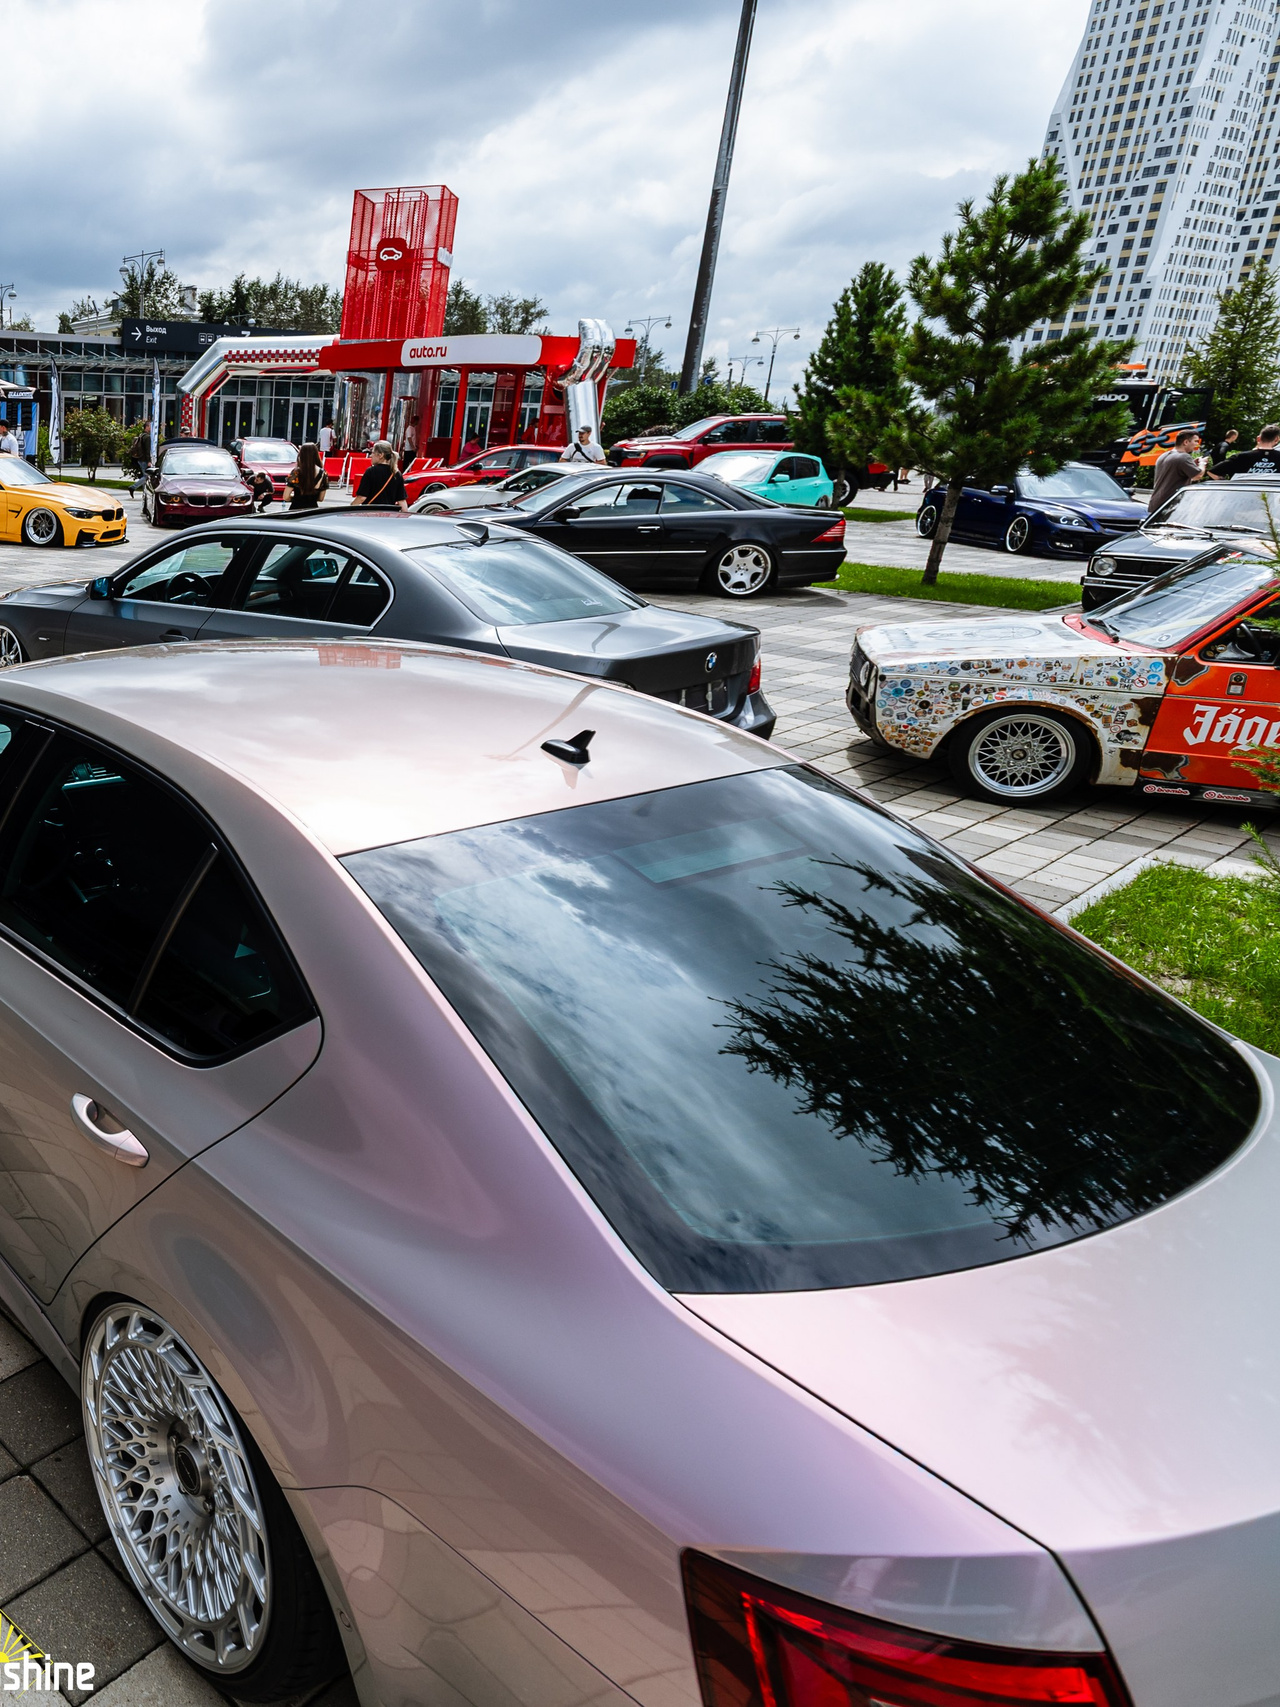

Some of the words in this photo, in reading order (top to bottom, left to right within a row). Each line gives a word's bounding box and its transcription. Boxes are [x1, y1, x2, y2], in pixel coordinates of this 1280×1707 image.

[146, 325, 167, 334] Выход
[146, 336, 157, 344] Exit
[409, 345, 448, 359] auto.ru
[1157, 787, 1189, 795] brembo
[1217, 793, 1250, 801] brembo
